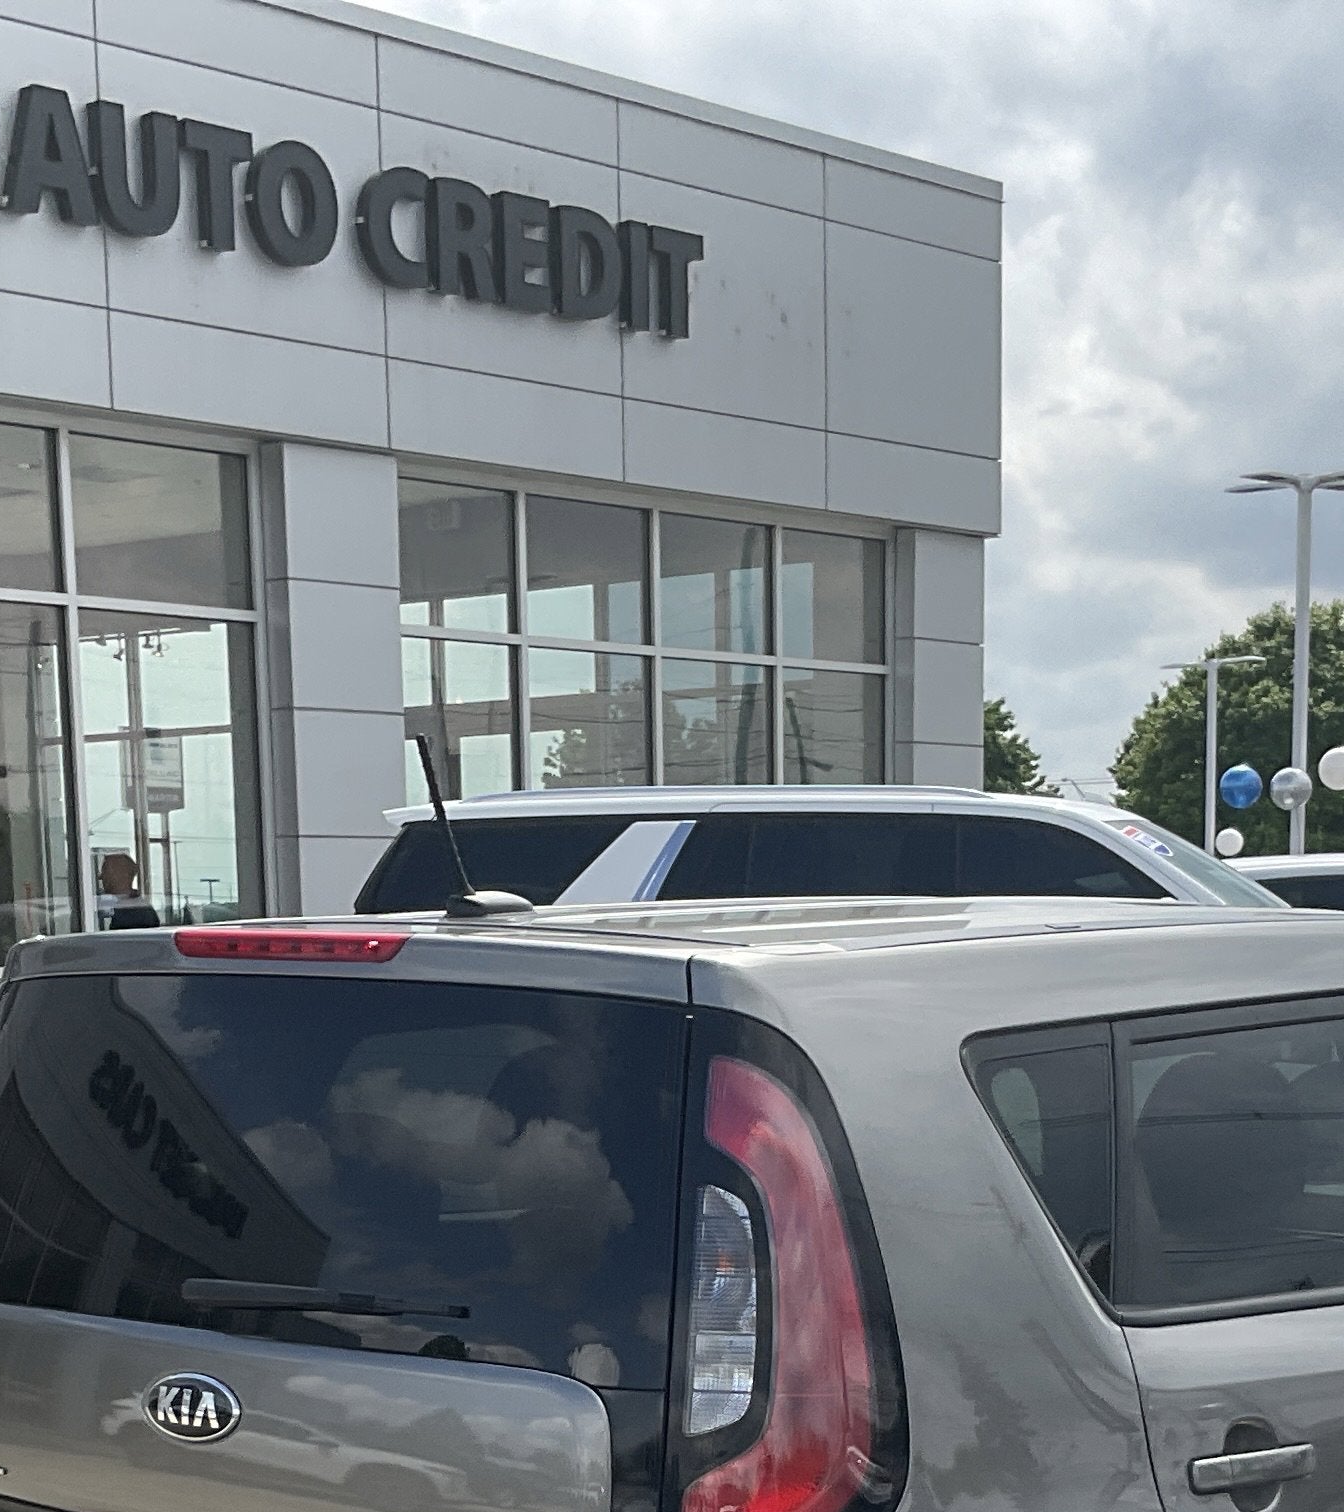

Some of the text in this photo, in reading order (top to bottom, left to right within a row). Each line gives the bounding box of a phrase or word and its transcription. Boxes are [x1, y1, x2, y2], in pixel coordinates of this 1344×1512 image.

[0, 83, 704, 339] AUTO CREDIT
[158, 1385, 219, 1429] KIA
